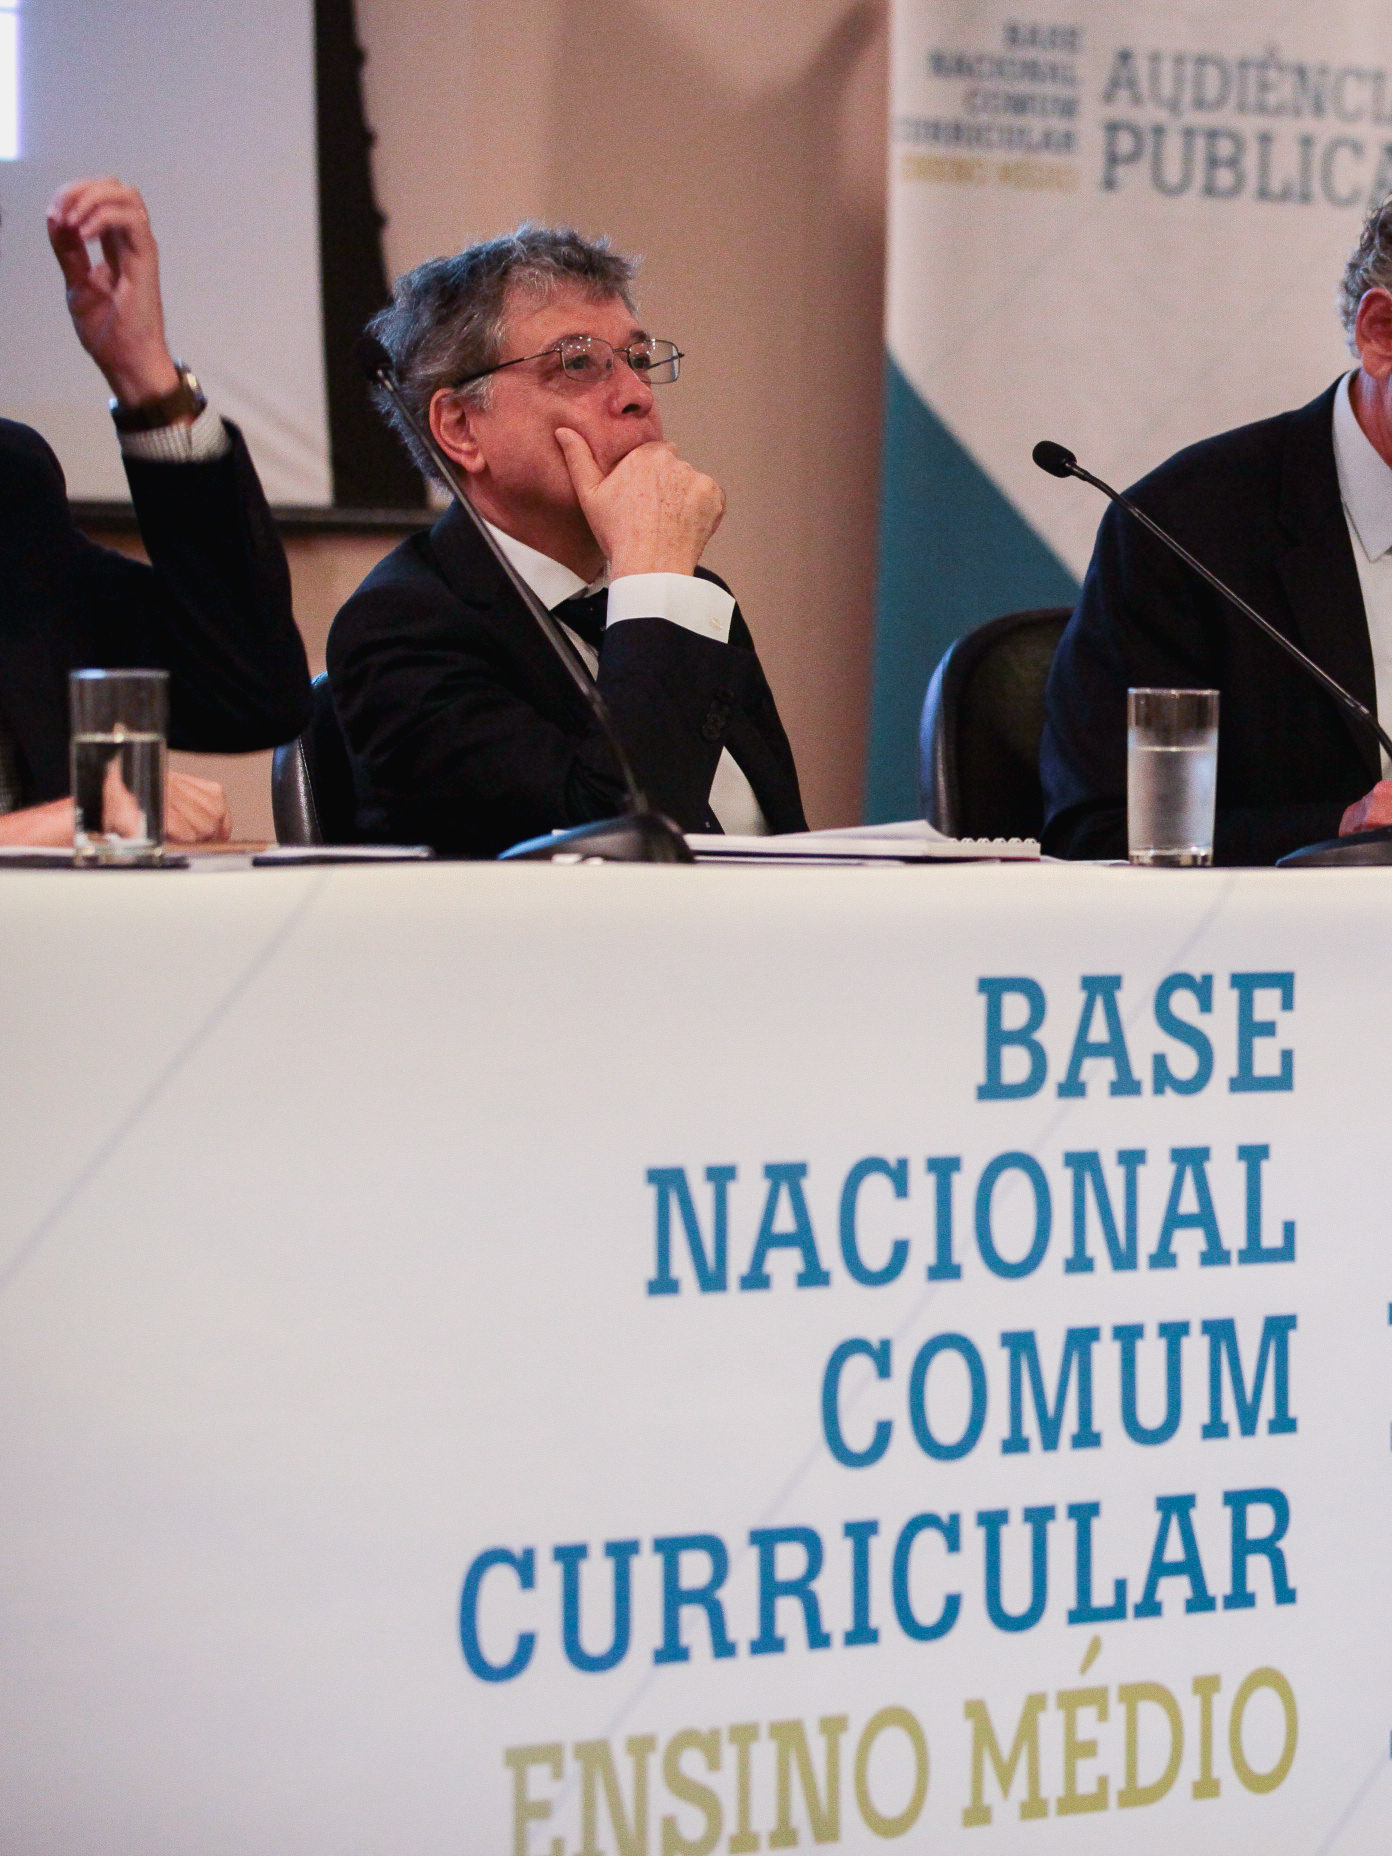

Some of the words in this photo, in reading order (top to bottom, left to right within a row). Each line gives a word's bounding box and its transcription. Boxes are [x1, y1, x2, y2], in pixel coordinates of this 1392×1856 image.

[976, 971, 1295, 1101] BASE
[646, 1143, 1297, 1296] NACIONAL
[820, 1314, 1299, 1469] COMUM
[458, 1487, 1298, 1684] CURRICULAR
[503, 1704, 930, 1856] ENSINO
[962, 1635, 1300, 1829] MÉDIO
